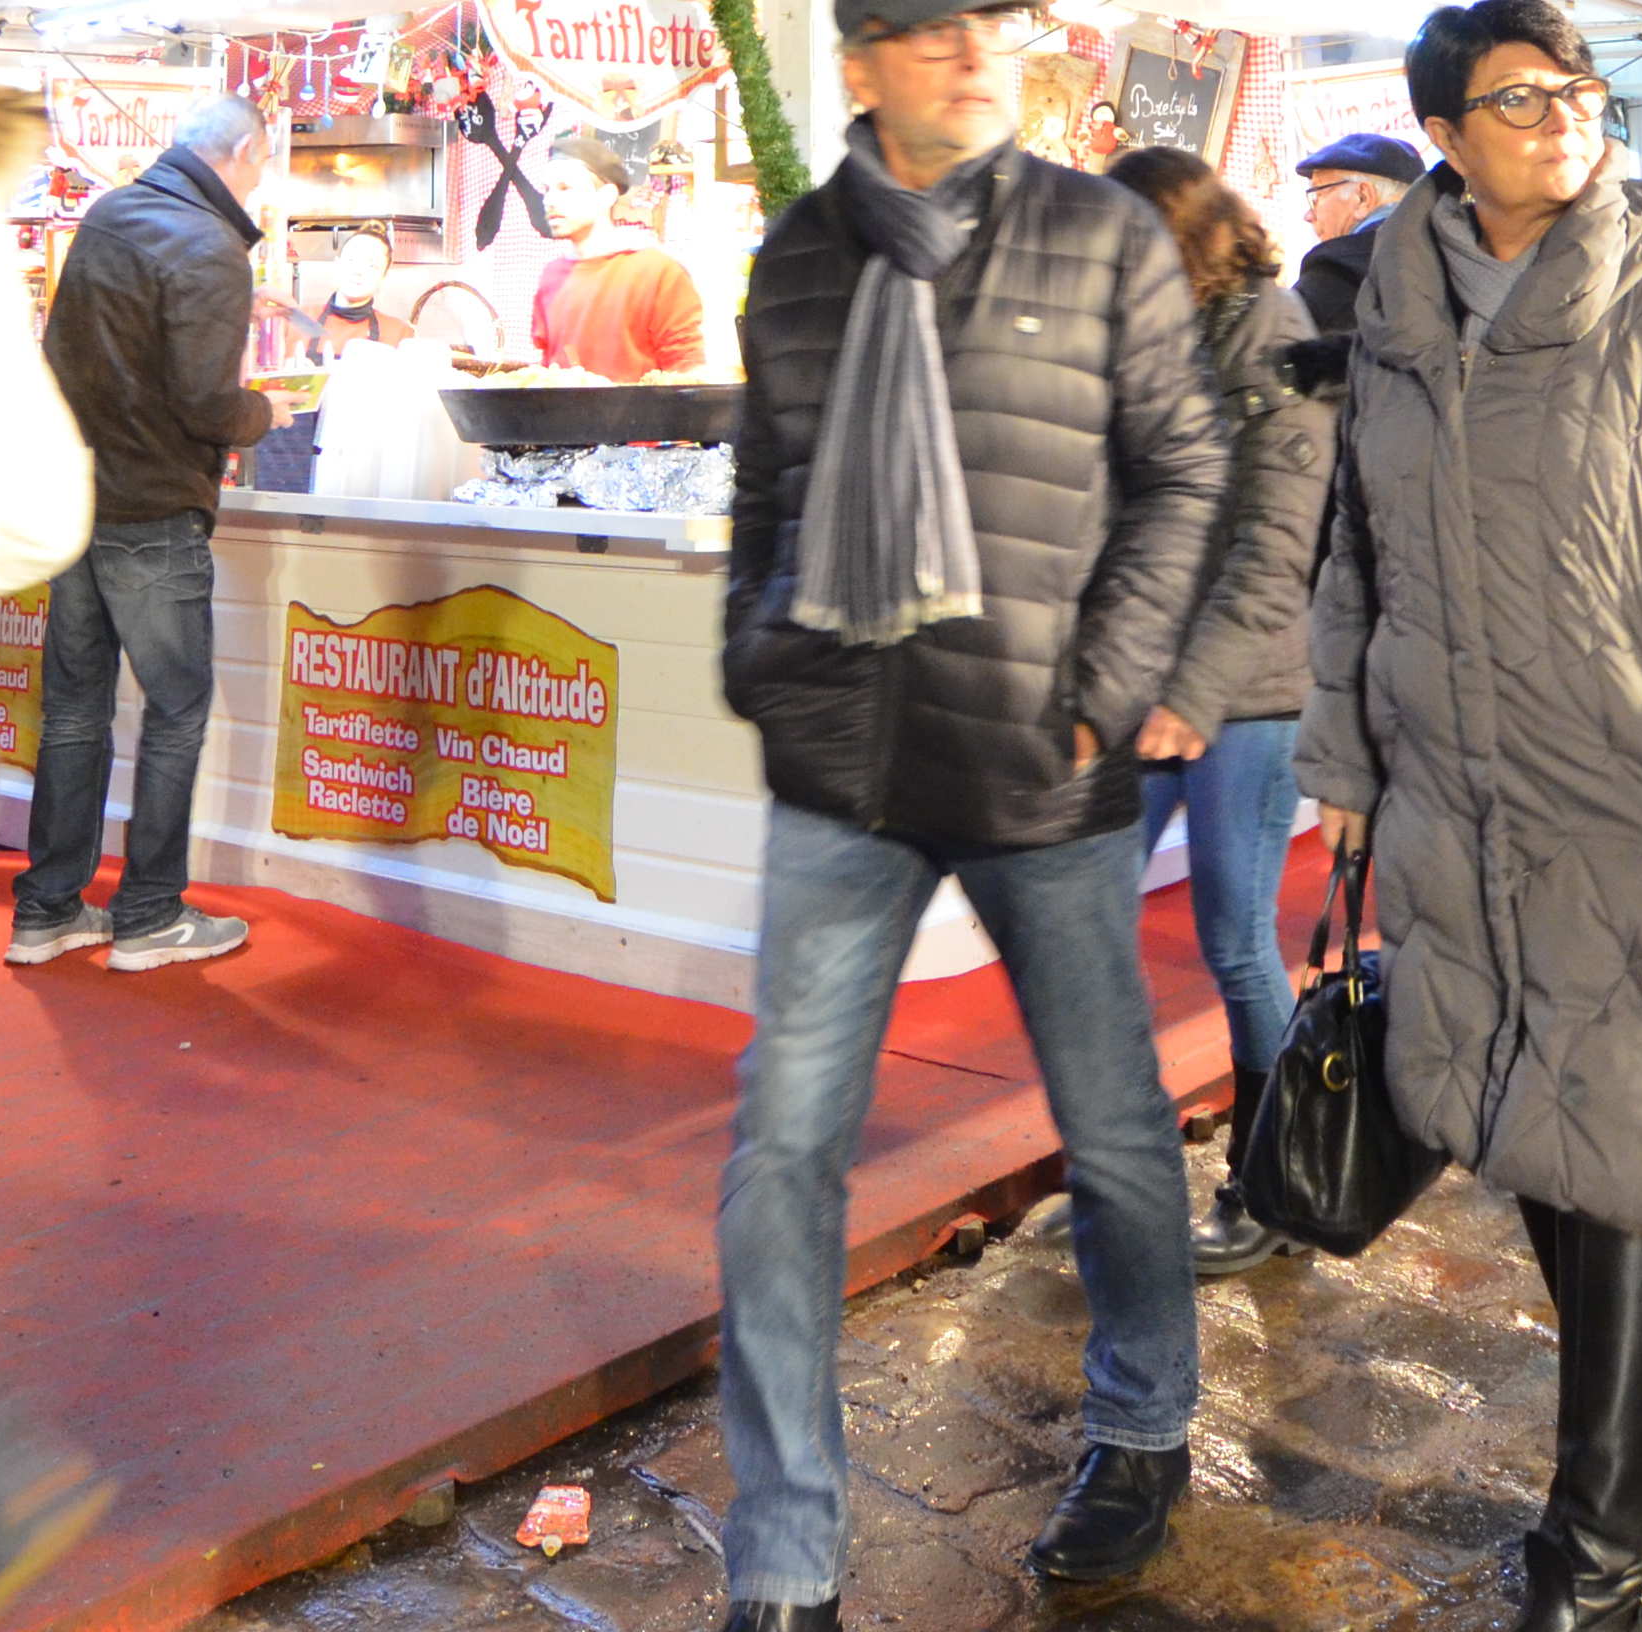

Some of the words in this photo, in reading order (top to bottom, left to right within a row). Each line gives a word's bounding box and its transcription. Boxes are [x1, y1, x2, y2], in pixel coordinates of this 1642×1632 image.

[71, 96, 178, 148] Tartiflett
[1369, 88, 1417, 133] cha
[292, 631, 461, 705] RESTAURANT
[467, 652, 605, 724] d'Altitude
[304, 706, 419, 750] Tartiflette
[437, 727, 473, 760] Vin
[482, 735, 565, 774] Chaud
[303, 749, 413, 794] Sandwich
[462, 777, 532, 815] Bière
[309, 780, 405, 822] Raclette
[448, 807, 478, 838] de
[487, 813, 546, 850] Noël
